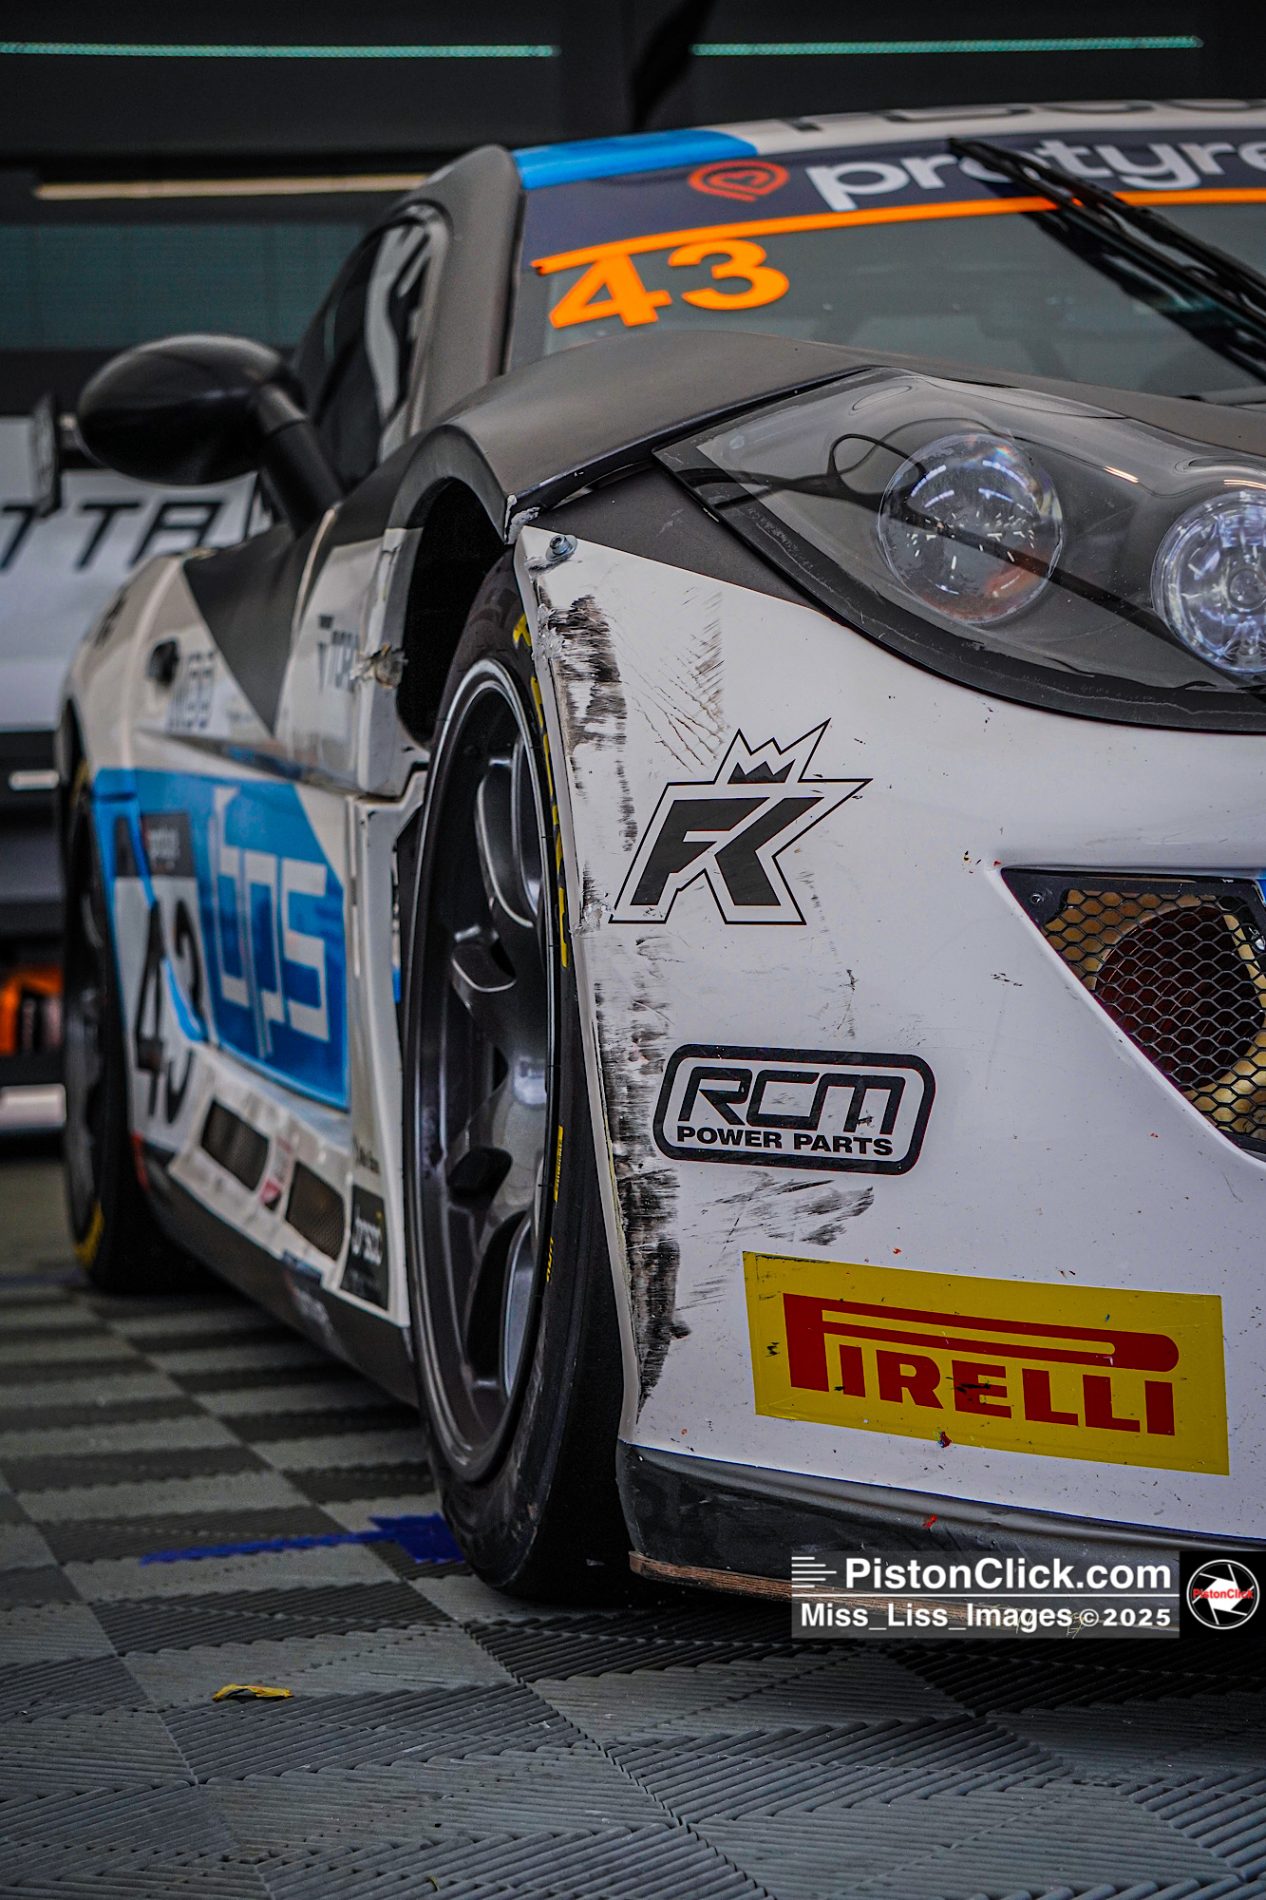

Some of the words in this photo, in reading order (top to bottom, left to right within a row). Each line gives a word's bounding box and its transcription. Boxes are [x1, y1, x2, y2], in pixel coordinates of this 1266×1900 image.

[549, 240, 790, 328] 43
[629, 796, 825, 906] FK
[135, 897, 204, 1124] 43
[676, 1125, 783, 1149] POWER
[793, 1132, 893, 1156] PARTS
[678, 1066, 906, 1135] RCM
[782, 1292, 1180, 1437] PIRELLI
